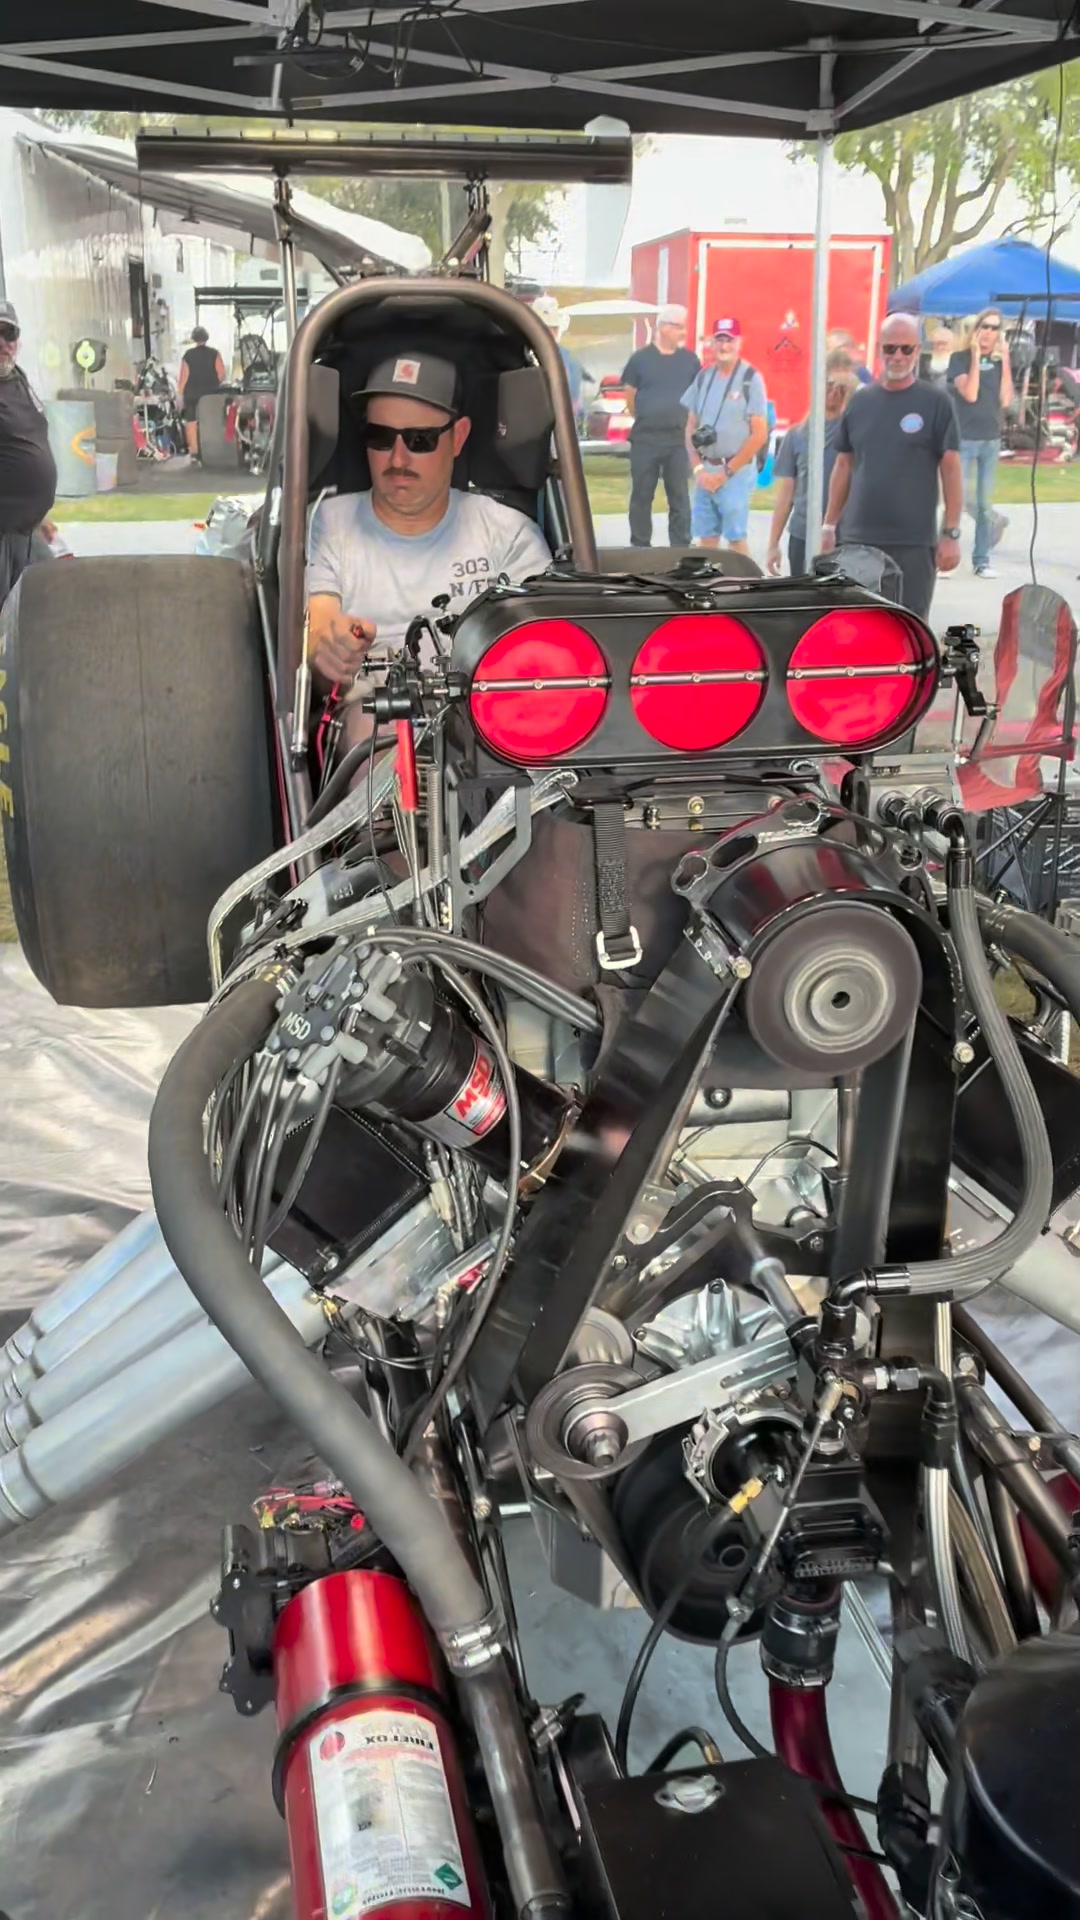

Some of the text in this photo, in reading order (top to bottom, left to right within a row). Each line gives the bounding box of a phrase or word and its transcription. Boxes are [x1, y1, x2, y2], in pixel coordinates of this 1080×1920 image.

[452, 557, 489, 578] 303
[281, 1011, 311, 1040] MSD
[455, 1054, 494, 1119] MSD
